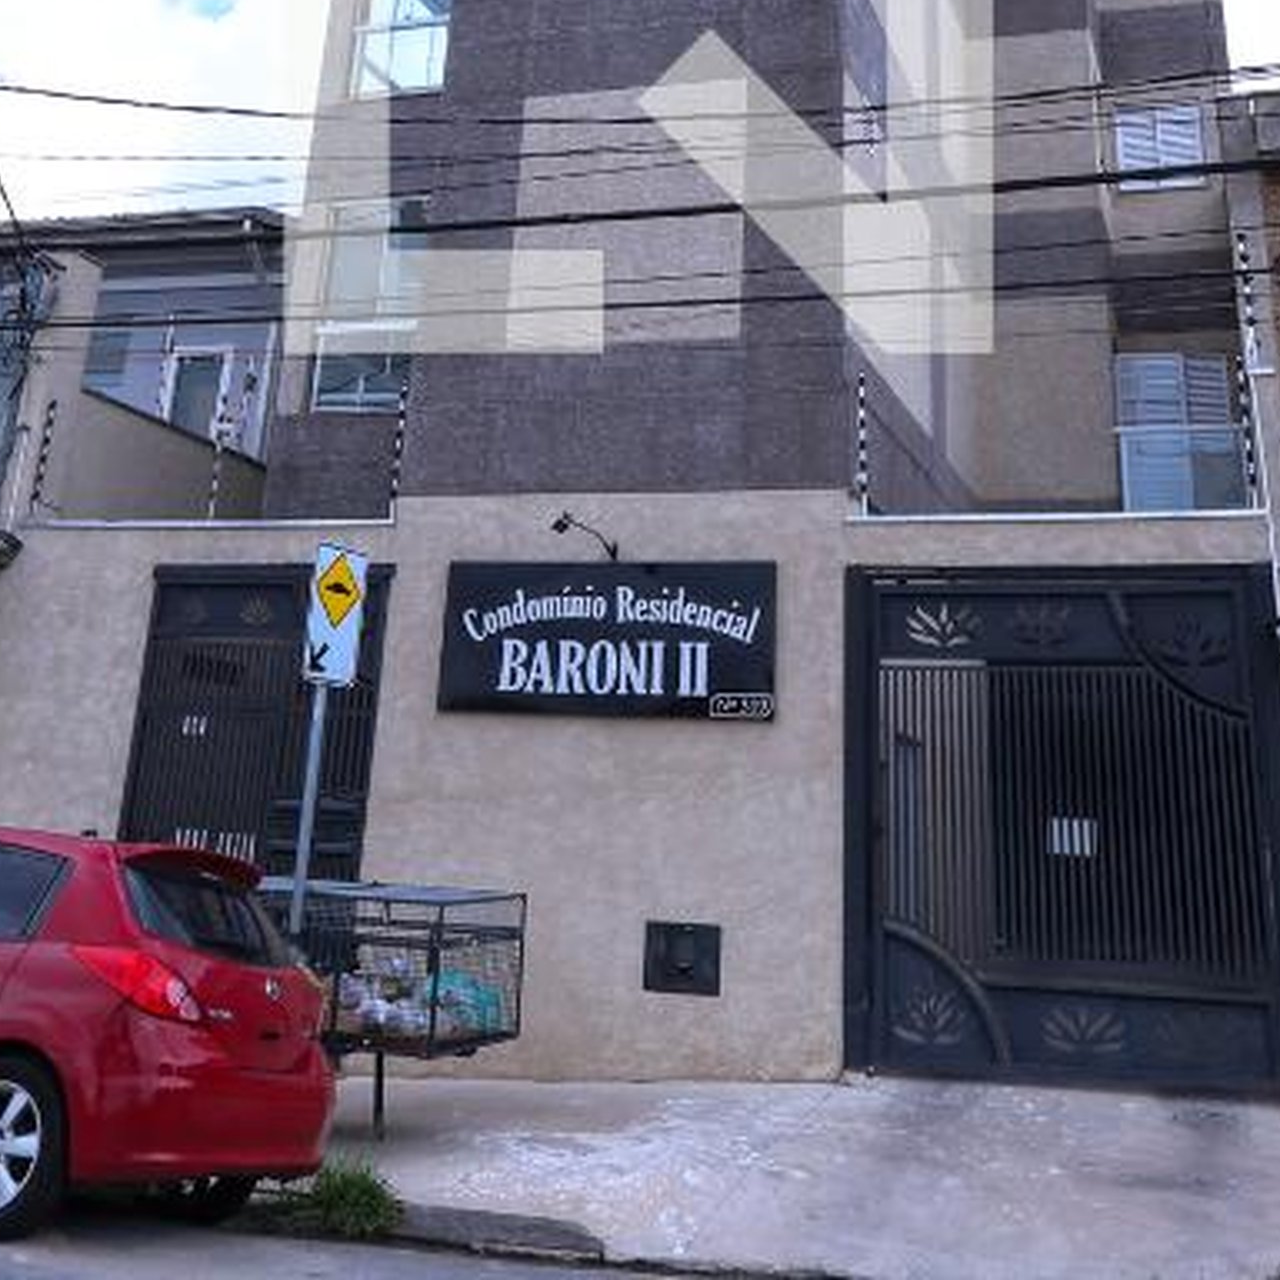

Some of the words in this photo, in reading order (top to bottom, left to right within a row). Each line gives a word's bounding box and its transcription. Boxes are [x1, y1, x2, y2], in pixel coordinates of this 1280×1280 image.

[463, 585, 607, 641] Condomínio
[616, 586, 761, 644] Residencial
[496, 638, 665, 696] BARONI
[677, 641, 709, 697] II
